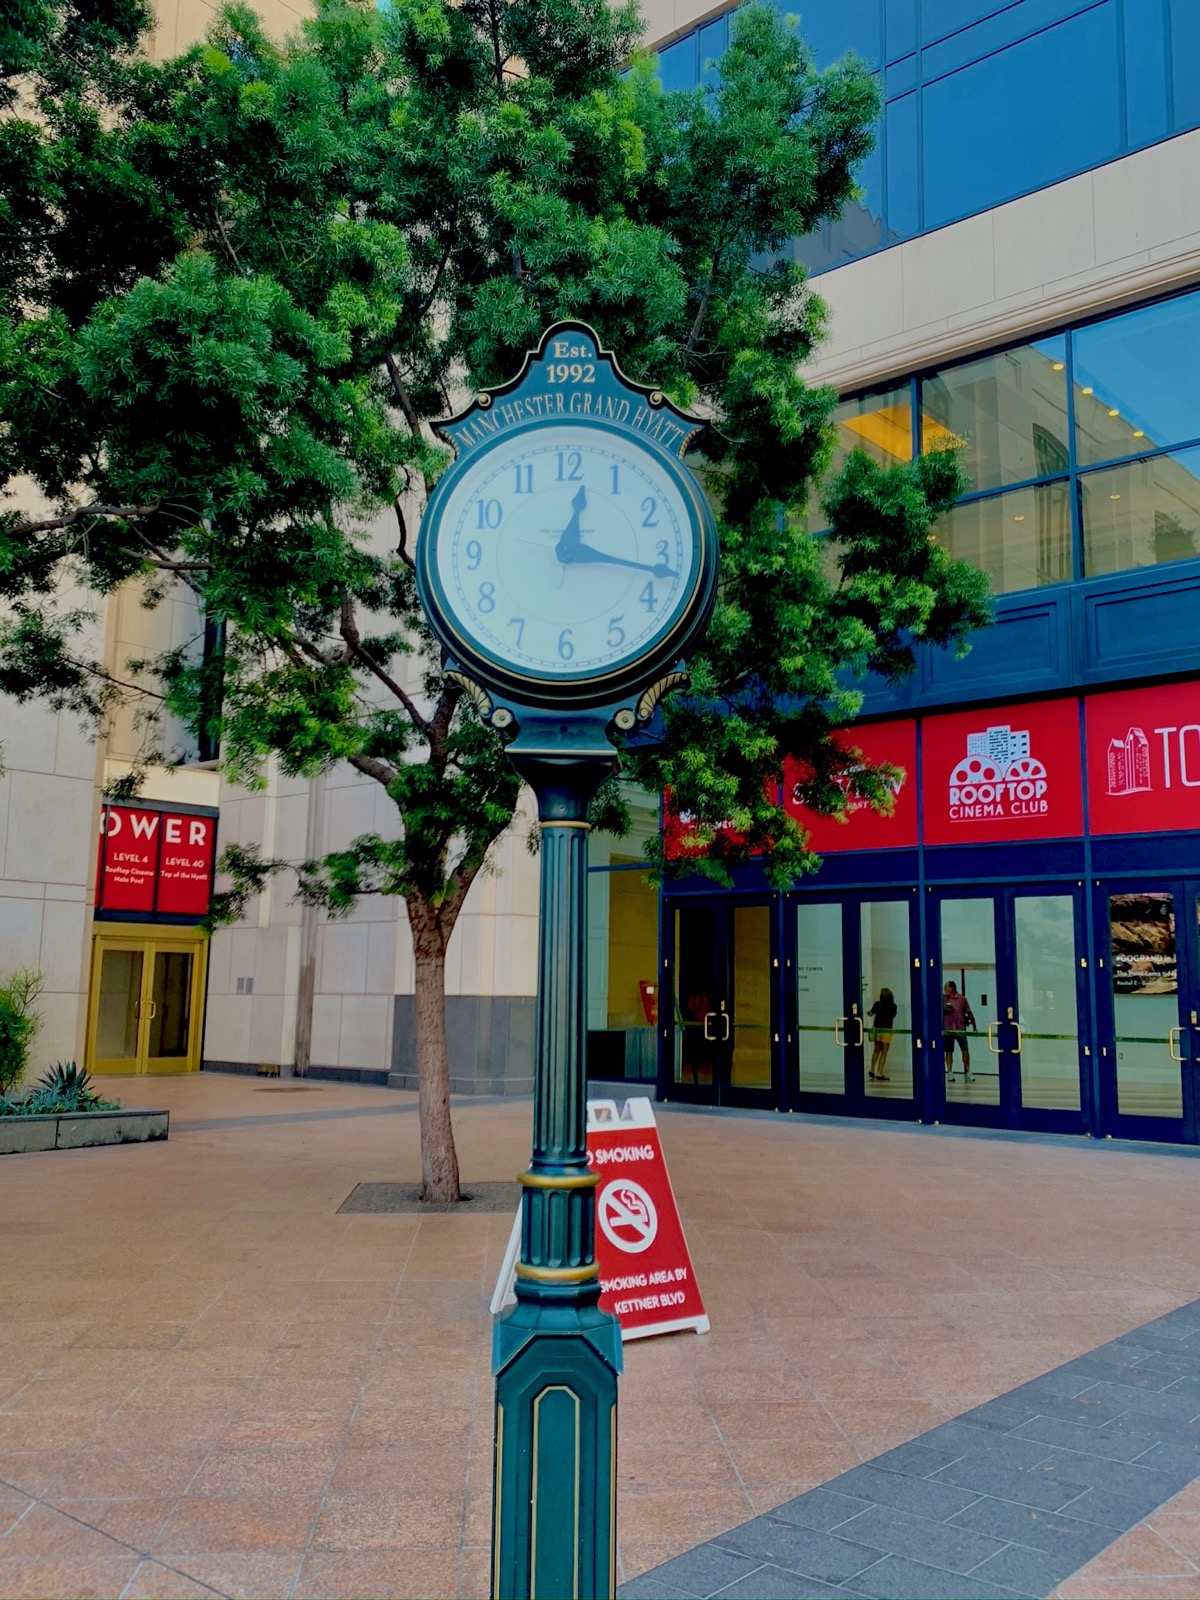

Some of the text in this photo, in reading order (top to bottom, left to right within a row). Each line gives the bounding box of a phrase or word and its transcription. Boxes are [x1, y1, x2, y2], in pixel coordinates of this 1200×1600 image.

[553, 341, 593, 359] Est.
[546, 364, 596, 383] 1992
[455, 392, 684, 449] MANCHESTER GRAND HYATT
[513, 464, 535, 494] 11
[555, 451, 584, 482] 12
[609, 464, 621, 495] 1
[475, 499, 503, 529] 10
[641, 497, 659, 528] 2
[466, 540, 482, 571] 9
[656, 540, 670, 568] 3
[477, 581, 496, 614] 8
[639, 580, 658, 613] 4
[506, 618, 526, 650] 7
[558, 629, 574, 660] 6
[607, 614, 625, 647] 5
[949, 780, 1048, 805] ROOFTOP
[949, 800, 1048, 819] CINEMA CLUB
[99, 811, 207, 846] OWER
[105, 865, 154, 876] Rooftop Cinema
[113, 852, 149, 863] LEVEL 4
[165, 857, 205, 868] LEVEL 40
[160, 870, 172, 878] Top
[595, 1144, 655, 1164] SMOKING
[600, 1266, 688, 1293] SMOKING AREA BY
[614, 1290, 686, 1315] KETTNER BLVD
